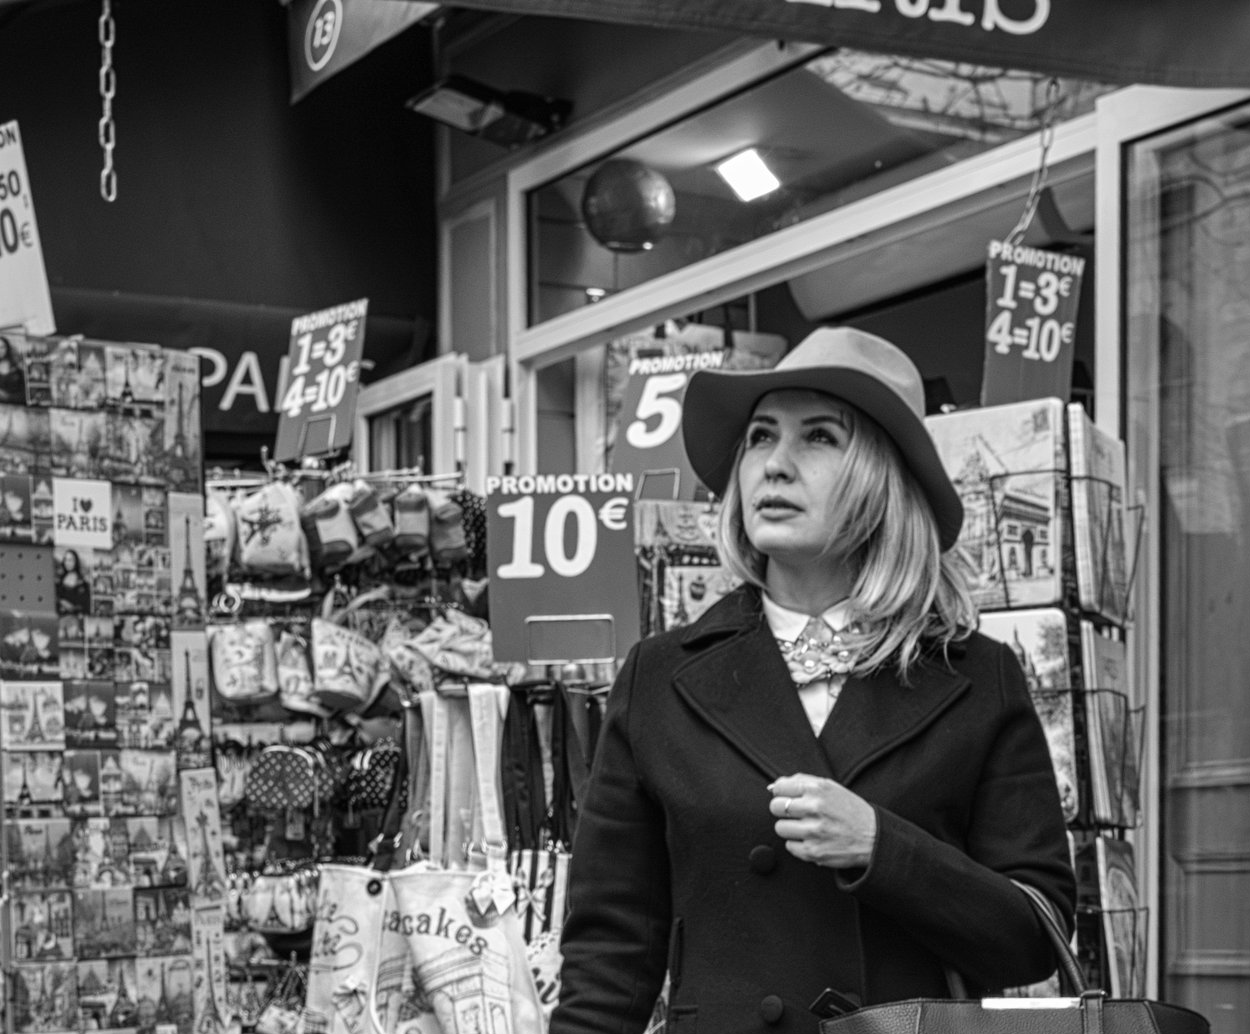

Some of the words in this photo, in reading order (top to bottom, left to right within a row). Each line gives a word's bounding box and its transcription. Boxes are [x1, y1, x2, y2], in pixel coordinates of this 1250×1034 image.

[313, 11, 335, 48] 13
[988, 239, 1085, 276] PROMOTION
[996, 264, 1073, 316] 1=3€
[291, 299, 367, 336] PROMOTION
[986, 309, 1075, 362] 4=10€
[292, 320, 359, 376] 1=3€
[628, 351, 724, 375] PROMOTION
[282, 361, 360, 418] 4=10€
[626, 373, 687, 448] 5
[485, 473, 634, 495] PROMOTION
[57, 513, 108, 533] PARIS
[497, 494, 629, 579] 10€
